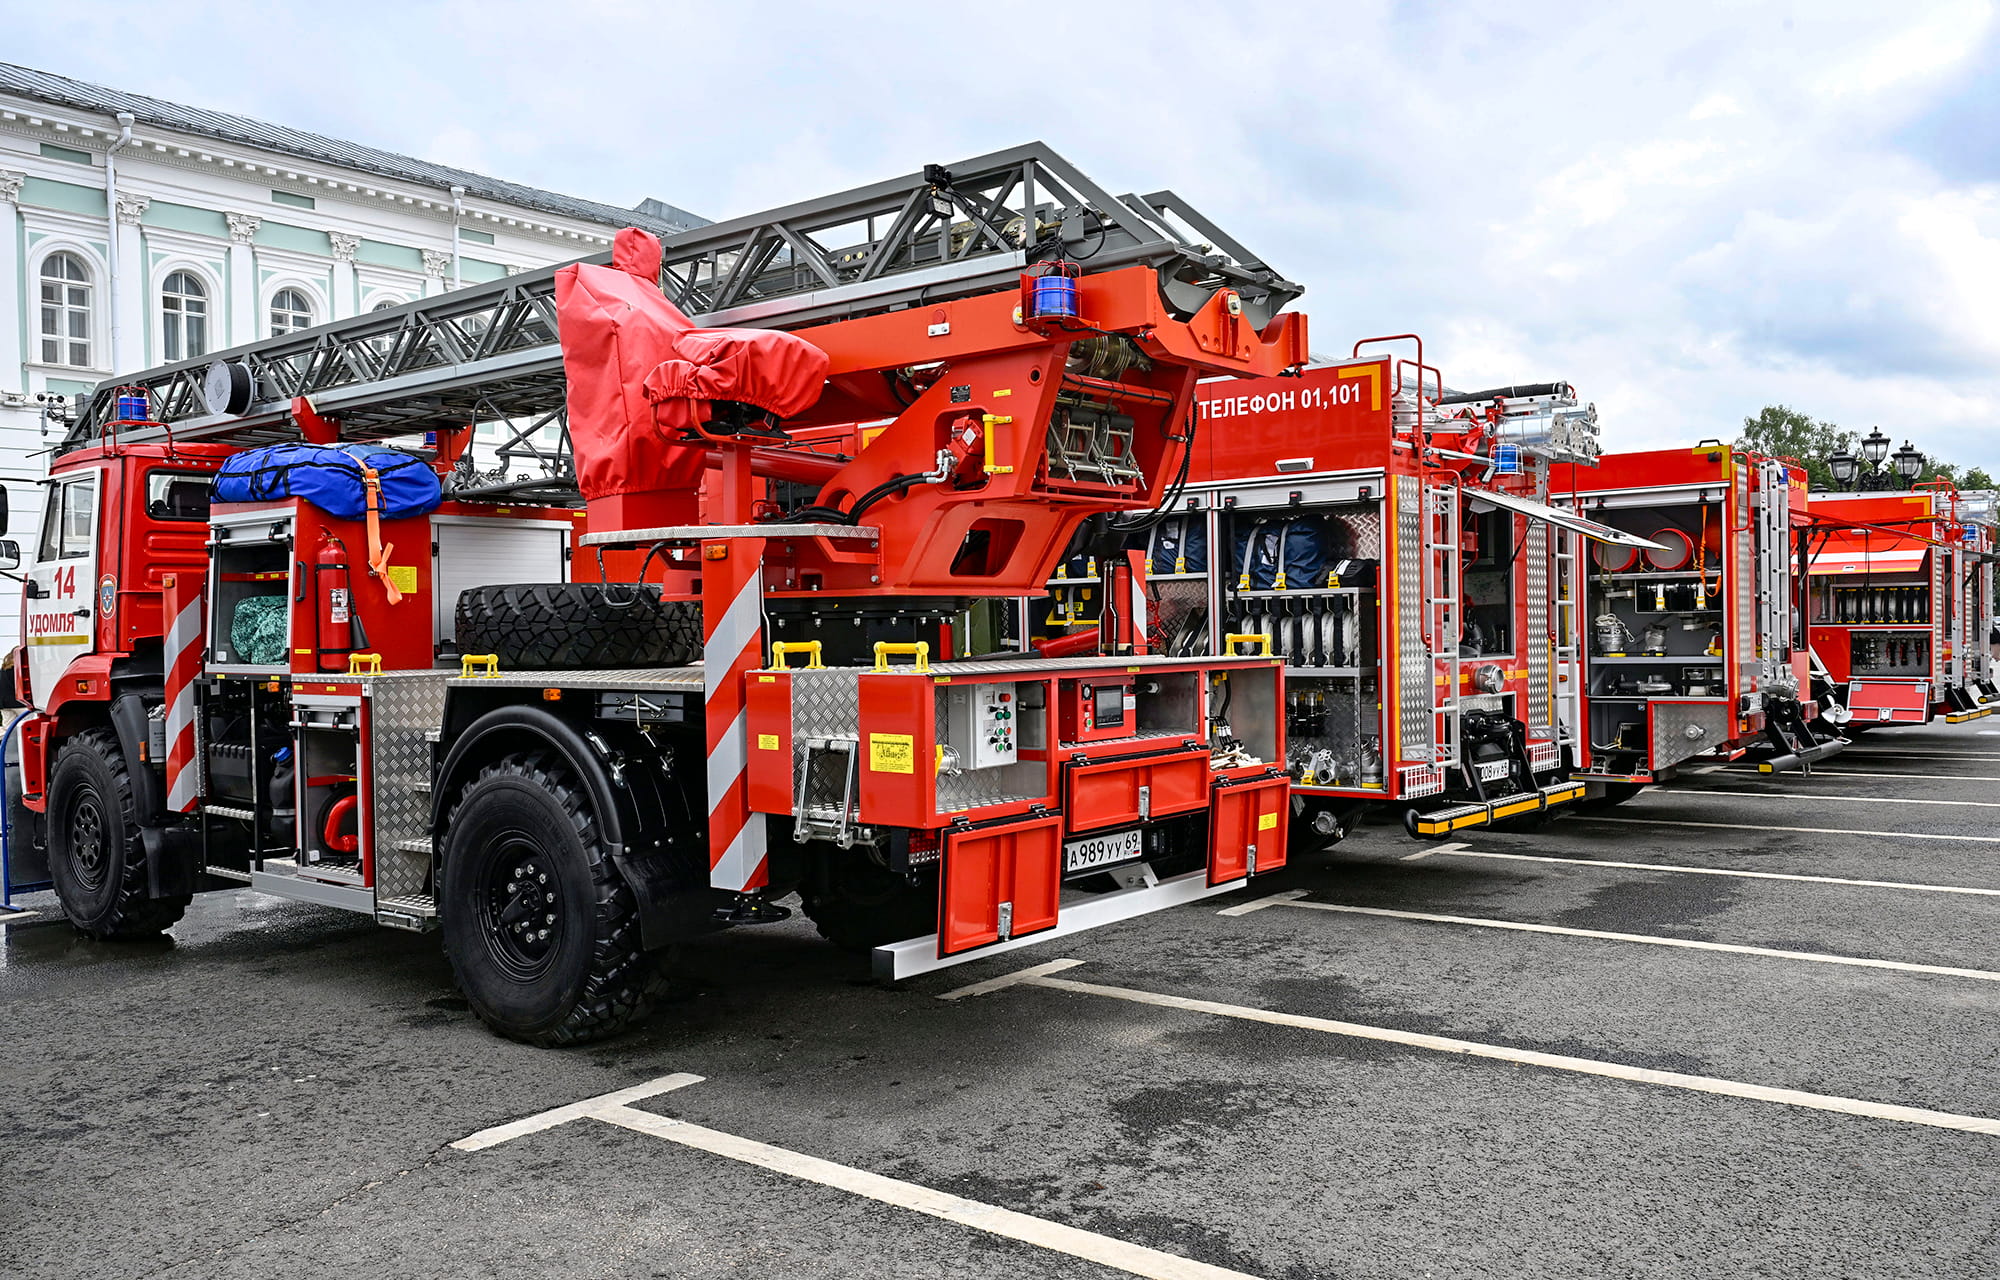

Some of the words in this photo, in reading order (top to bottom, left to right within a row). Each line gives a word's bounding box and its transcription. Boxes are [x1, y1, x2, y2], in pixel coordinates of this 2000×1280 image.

[1199, 390, 1295, 420] ТЕЛЕФОН
[1301, 382, 1360, 410] 01,101
[54, 565, 76, 600] 14
[29, 612, 75, 637] УДОМЛЯ
[1125, 832, 1138, 850] 69
